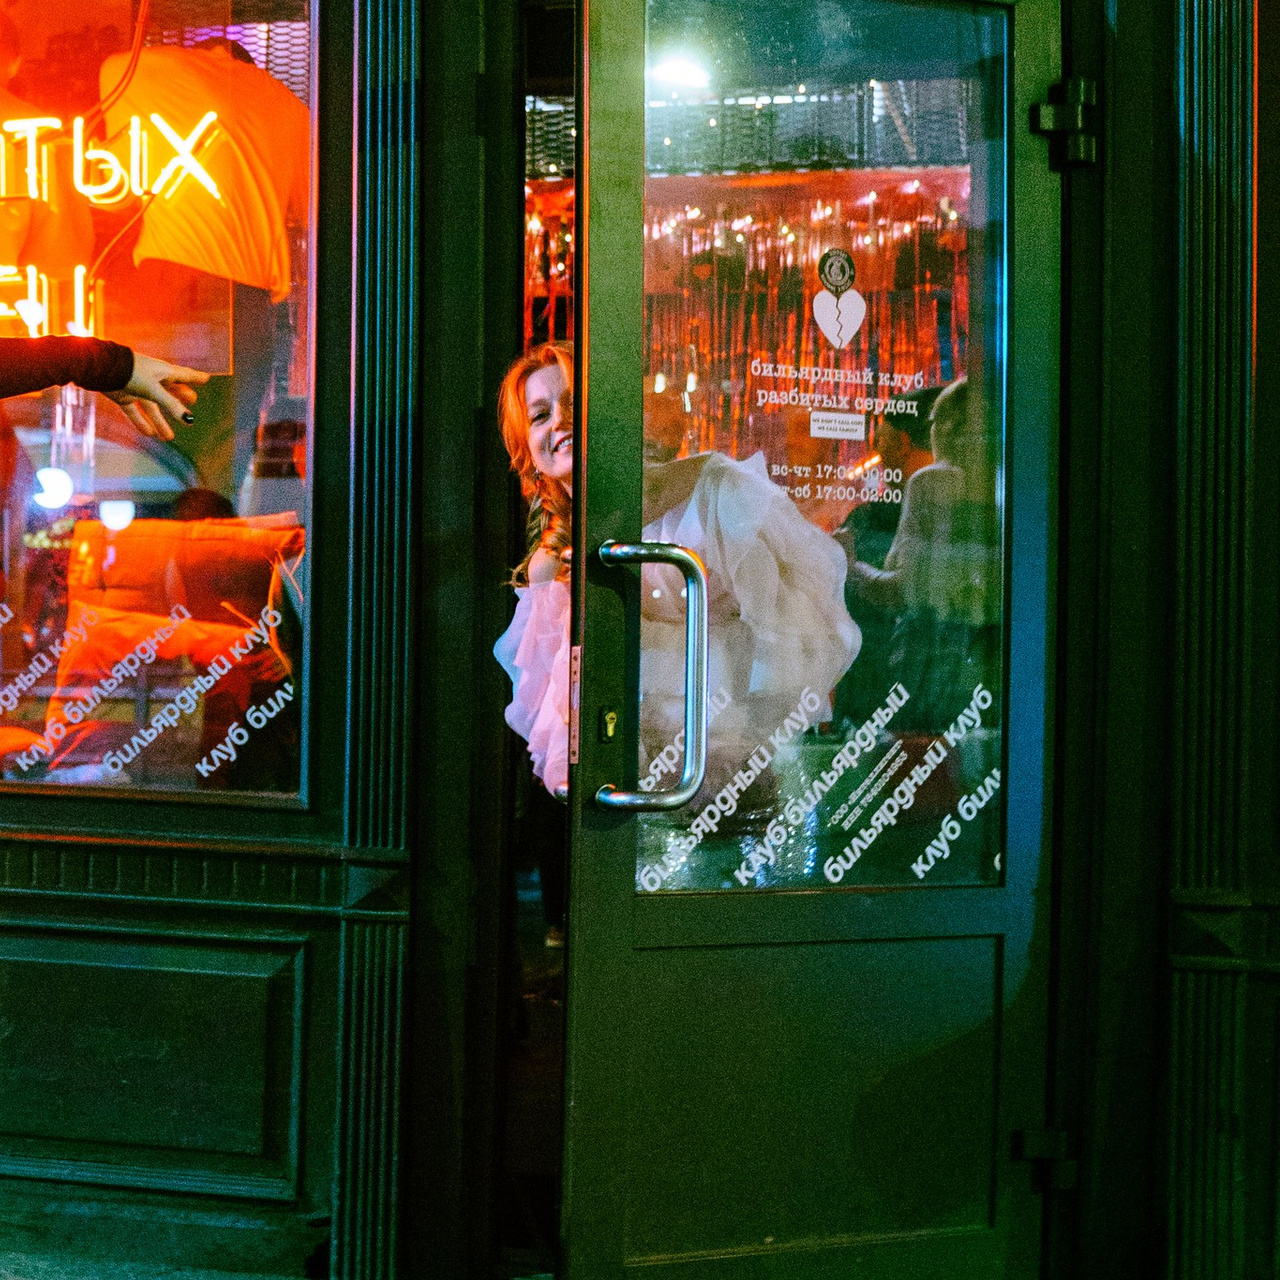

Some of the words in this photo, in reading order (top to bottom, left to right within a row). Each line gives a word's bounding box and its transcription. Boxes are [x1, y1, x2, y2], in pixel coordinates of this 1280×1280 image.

[750, 358, 874, 385] бильярдный
[878, 371, 924, 390] клуб
[756, 389, 850, 410] разбитых
[854, 397, 919, 417] сердец
[771, 464, 812, 478] вс-чт
[782, 483, 811, 499] т-сб
[815, 485, 903, 503] 17:00-02:00
[49, 605, 99, 659] клуб
[14, 717, 67, 772] клуб
[63, 603, 192, 724] бильярдный
[102, 654, 233, 773] бильярдный
[228, 604, 282, 662] клуб
[769, 685, 821, 751] клуб
[195, 721, 250, 778] клуб
[733, 818, 788, 886] клуб
[784, 681, 911, 826] бильярдный
[823, 739, 948, 884] бильярдный
[943, 683, 993, 747] клуб
[910, 813, 962, 880] клуб
